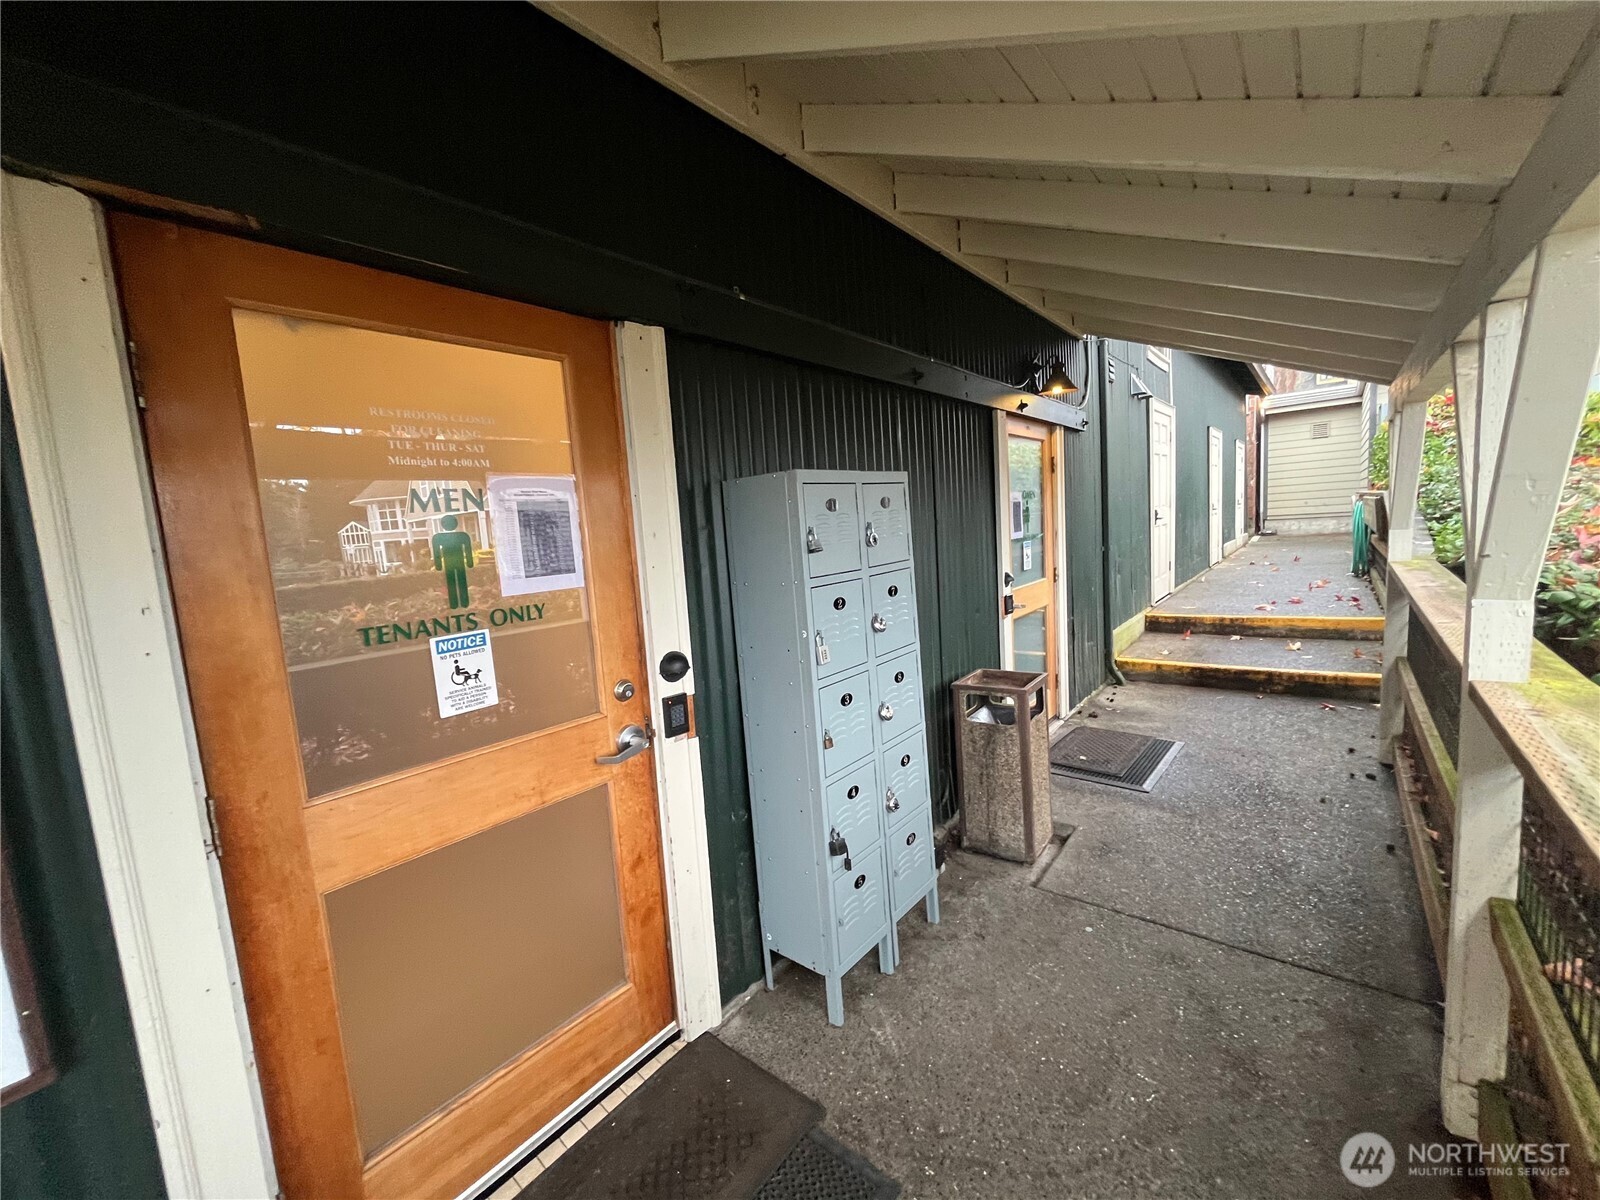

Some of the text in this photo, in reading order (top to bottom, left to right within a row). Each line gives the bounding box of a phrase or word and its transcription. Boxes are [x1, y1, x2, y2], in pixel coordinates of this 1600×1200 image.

[369, 406, 448, 421] RESTROOMS
[388, 440, 413, 450] TUE
[422, 441, 458, 452] THUR
[465, 444, 486, 453] SAT
[388, 456, 490, 468] Midnight to 4:00AM
[409, 488, 484, 513] MEN
[357, 603, 546, 647] TENANTS ONLY
[438, 634, 484, 653] NOTICE
[463, 647, 486, 656] ALLOWED
